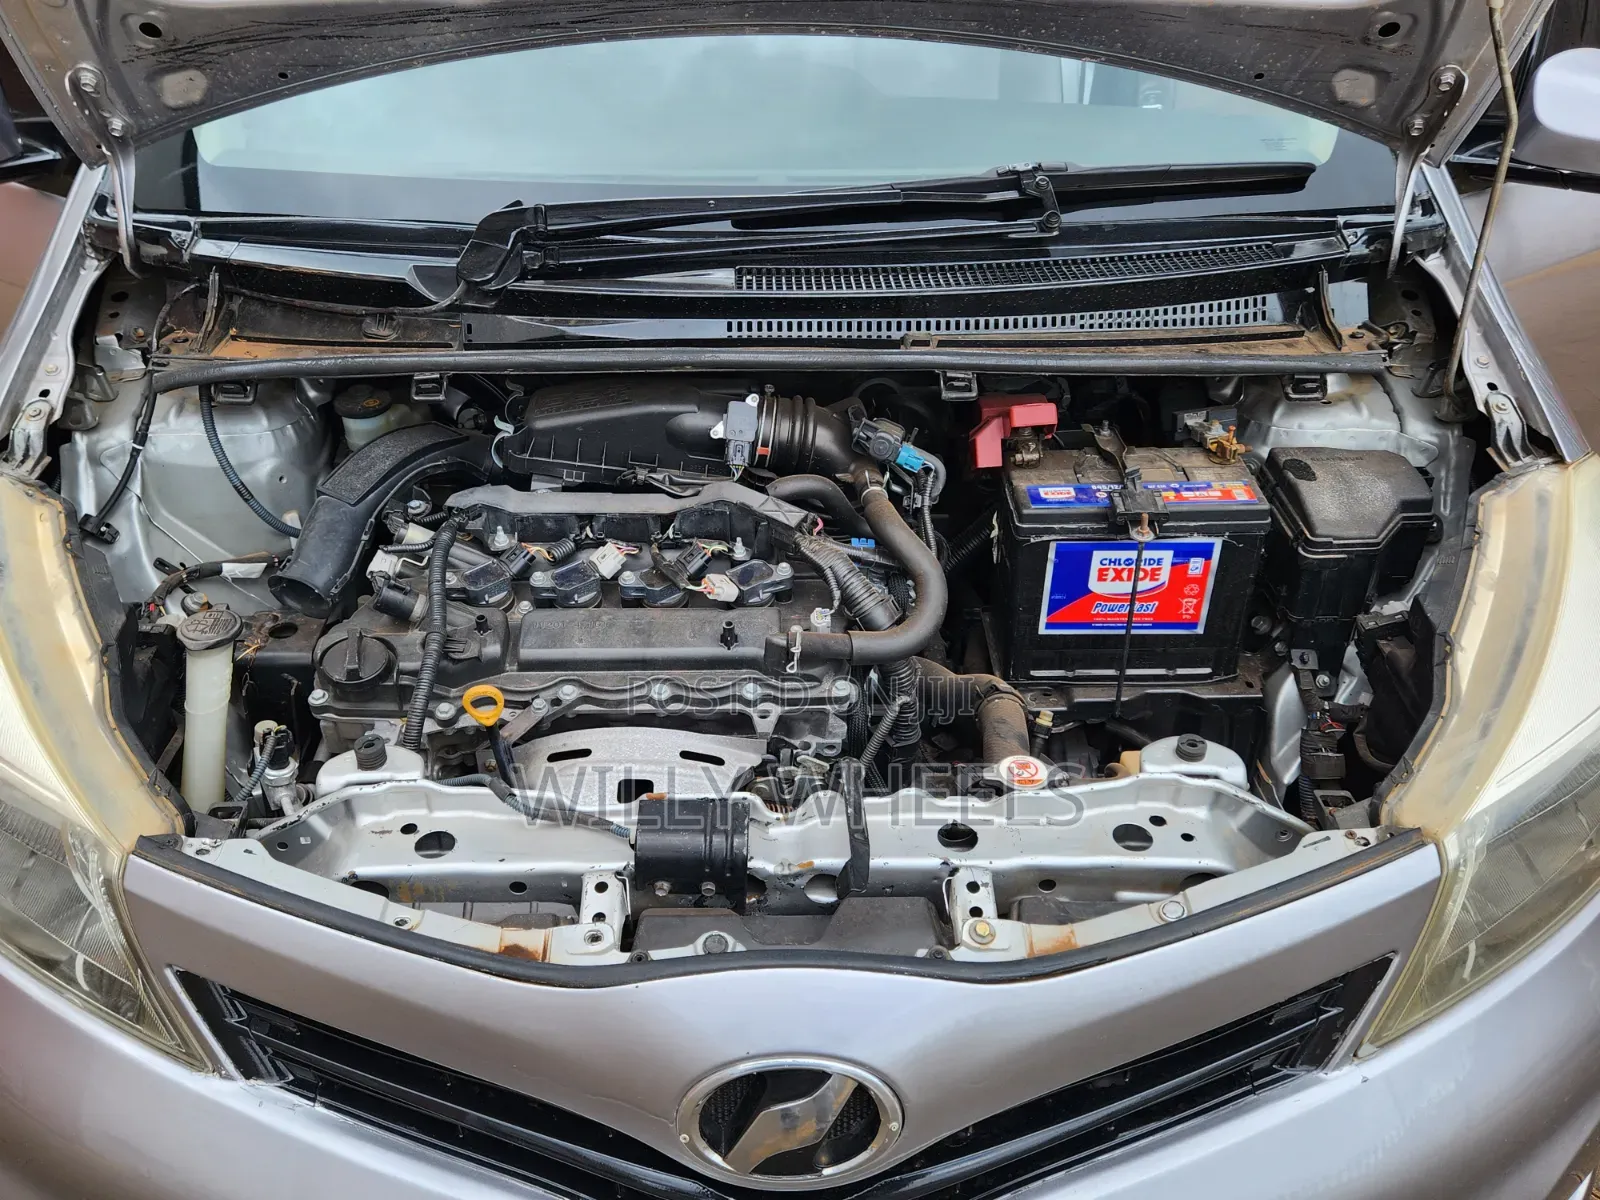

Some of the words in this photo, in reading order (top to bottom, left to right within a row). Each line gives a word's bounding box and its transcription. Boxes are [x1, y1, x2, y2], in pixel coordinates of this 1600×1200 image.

[1099, 557, 1165, 566] CHLOIDE
[1096, 567, 1164, 582] EXIDE
[1092, 601, 1158, 613] Powerast
